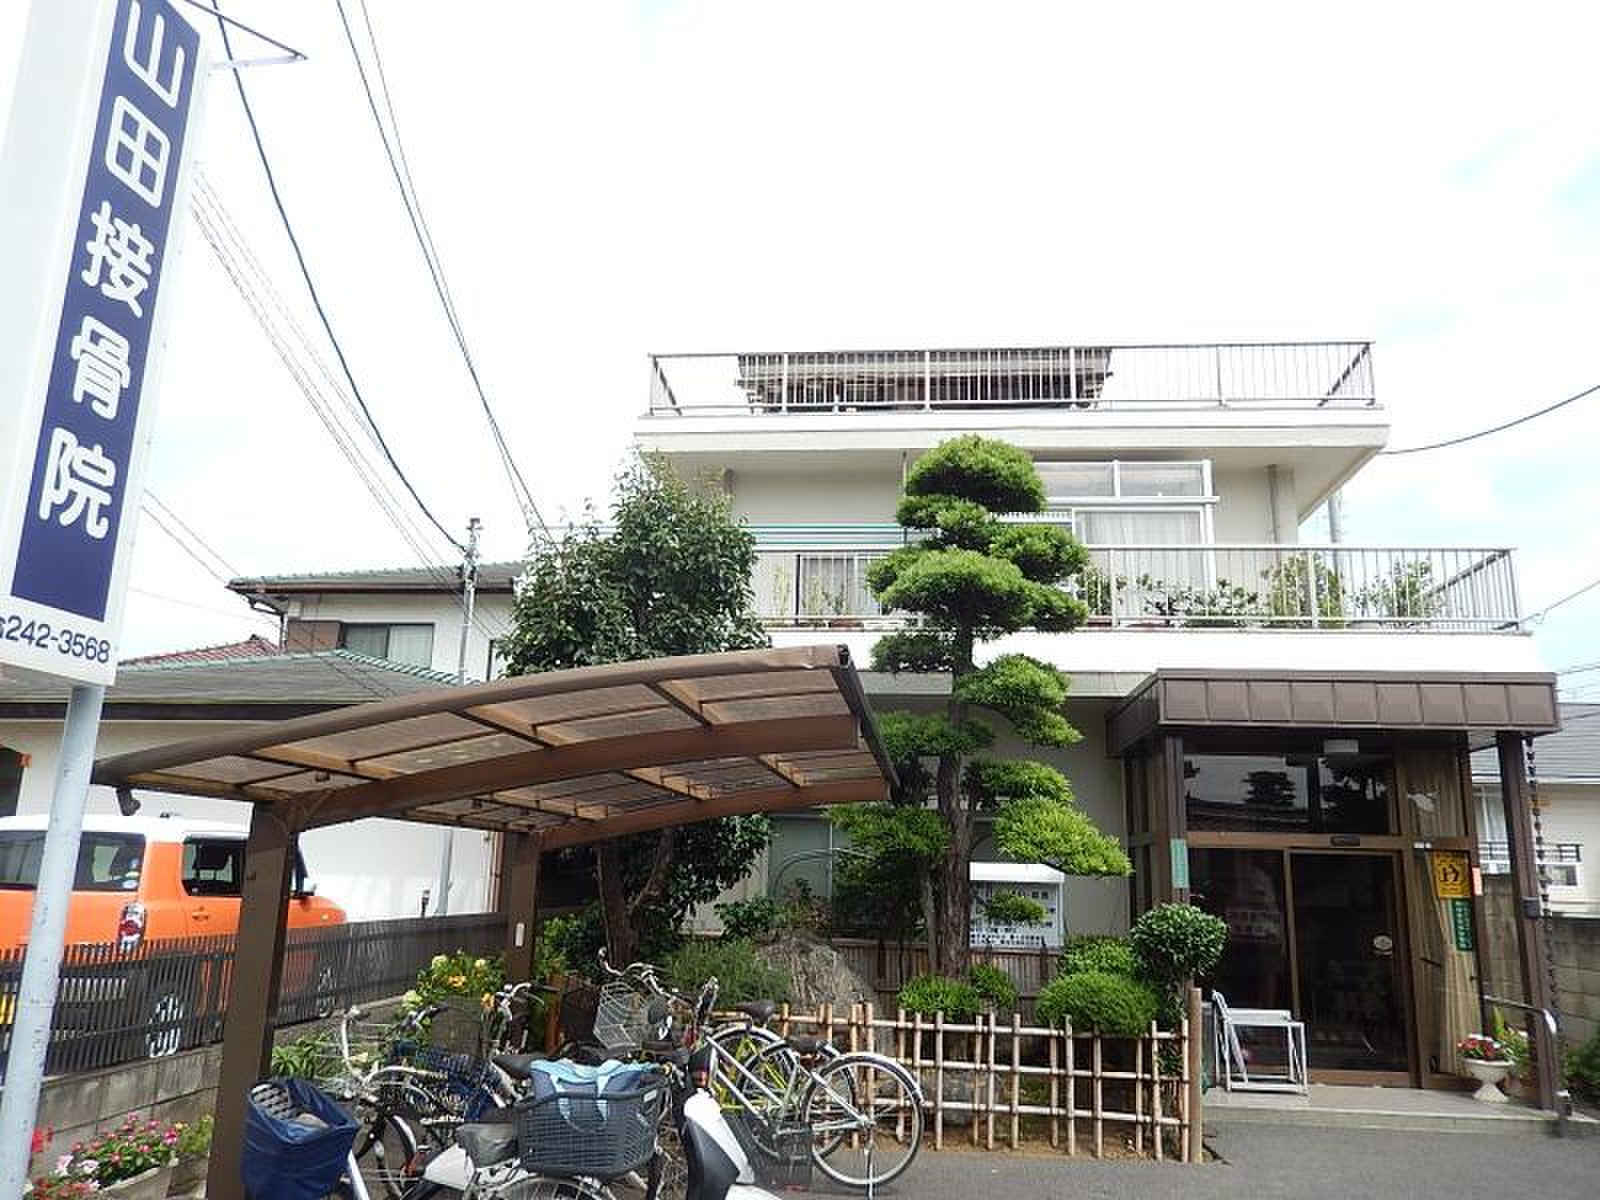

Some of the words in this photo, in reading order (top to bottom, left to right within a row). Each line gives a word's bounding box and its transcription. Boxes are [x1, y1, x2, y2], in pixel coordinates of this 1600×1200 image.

[38, 0, 186, 540] 山田接骨院
